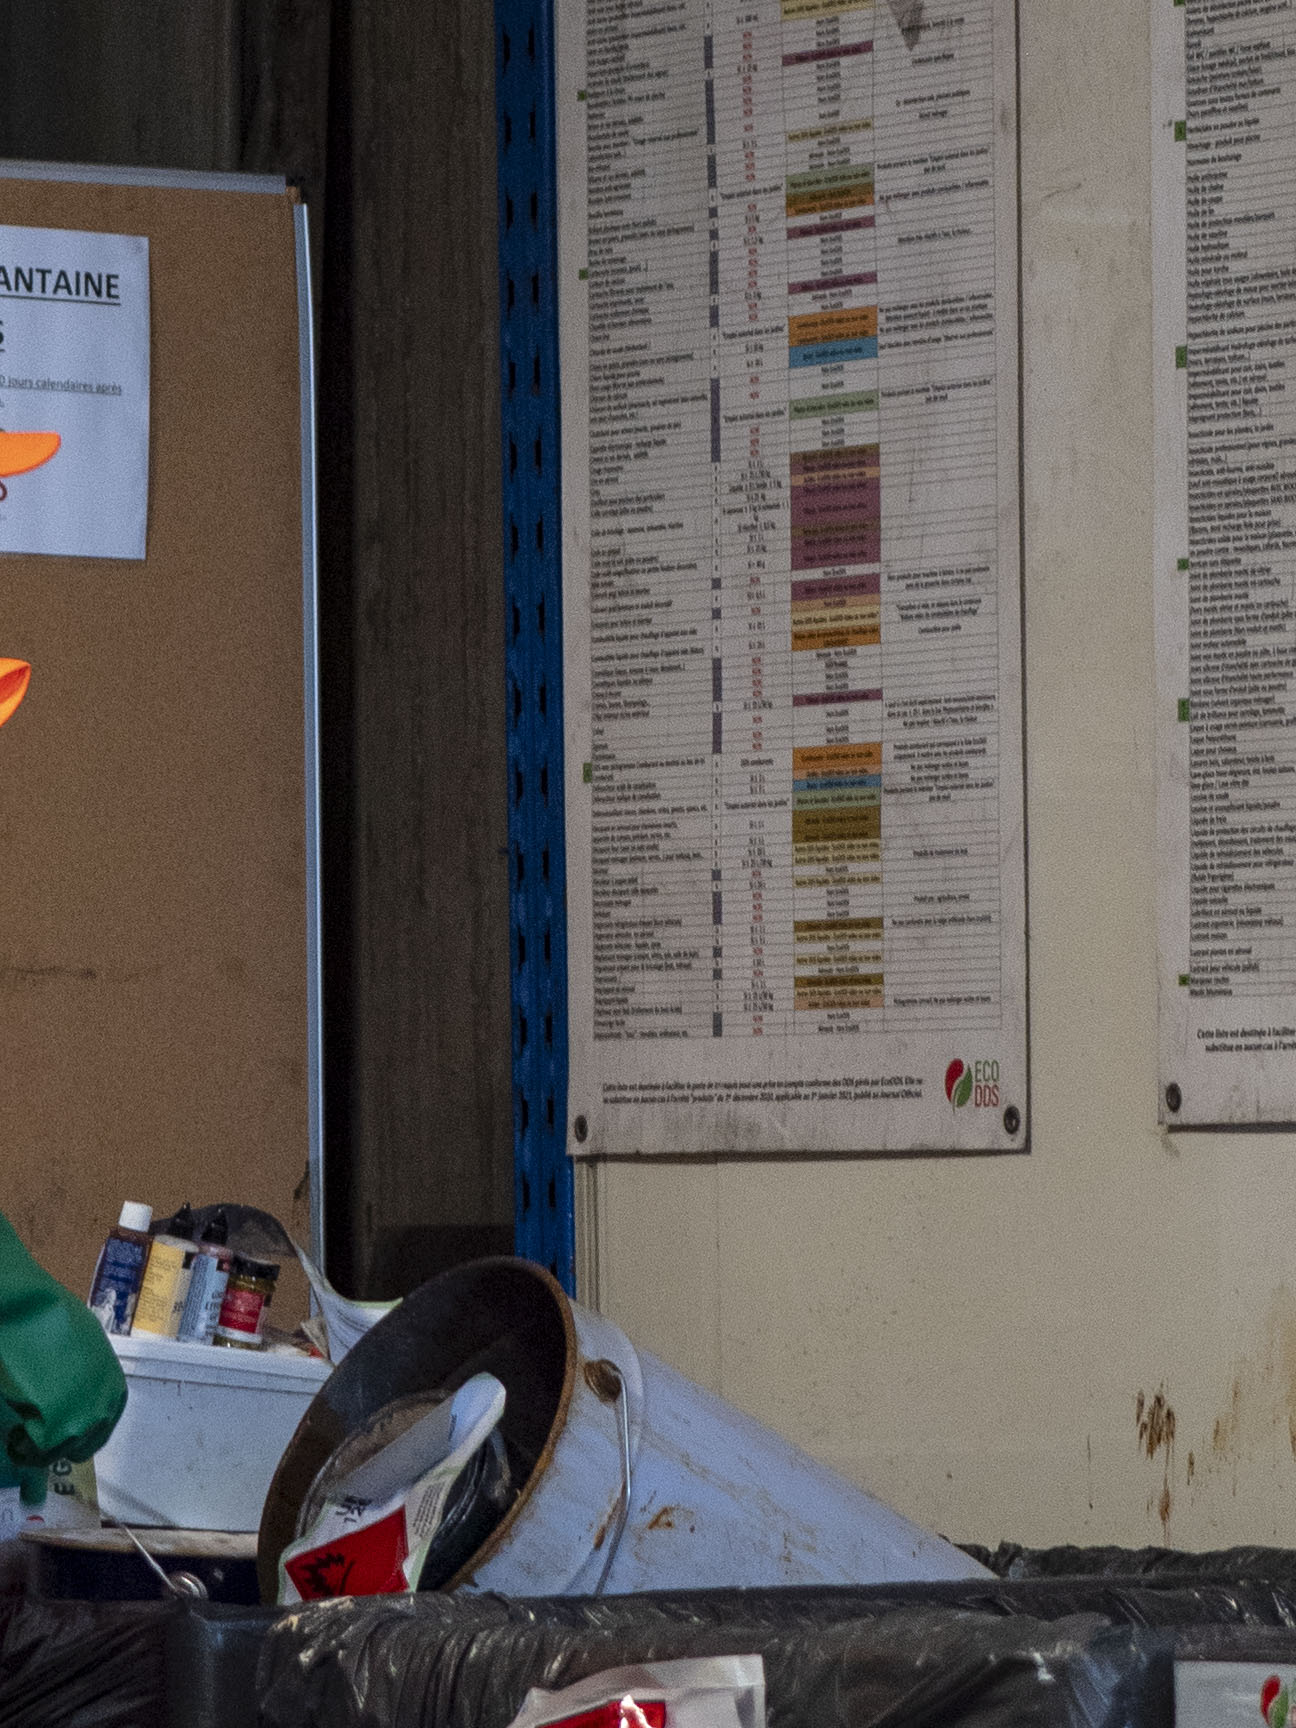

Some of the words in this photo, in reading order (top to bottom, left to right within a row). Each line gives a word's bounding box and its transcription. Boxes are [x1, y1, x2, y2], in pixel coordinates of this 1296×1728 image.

[7, 375, 33, 391] jours
[35, 376, 93, 392] calendaires
[95, 380, 122, 398] après
[974, 1061, 999, 1083] ECO
[974, 1085, 999, 1108] DDS
